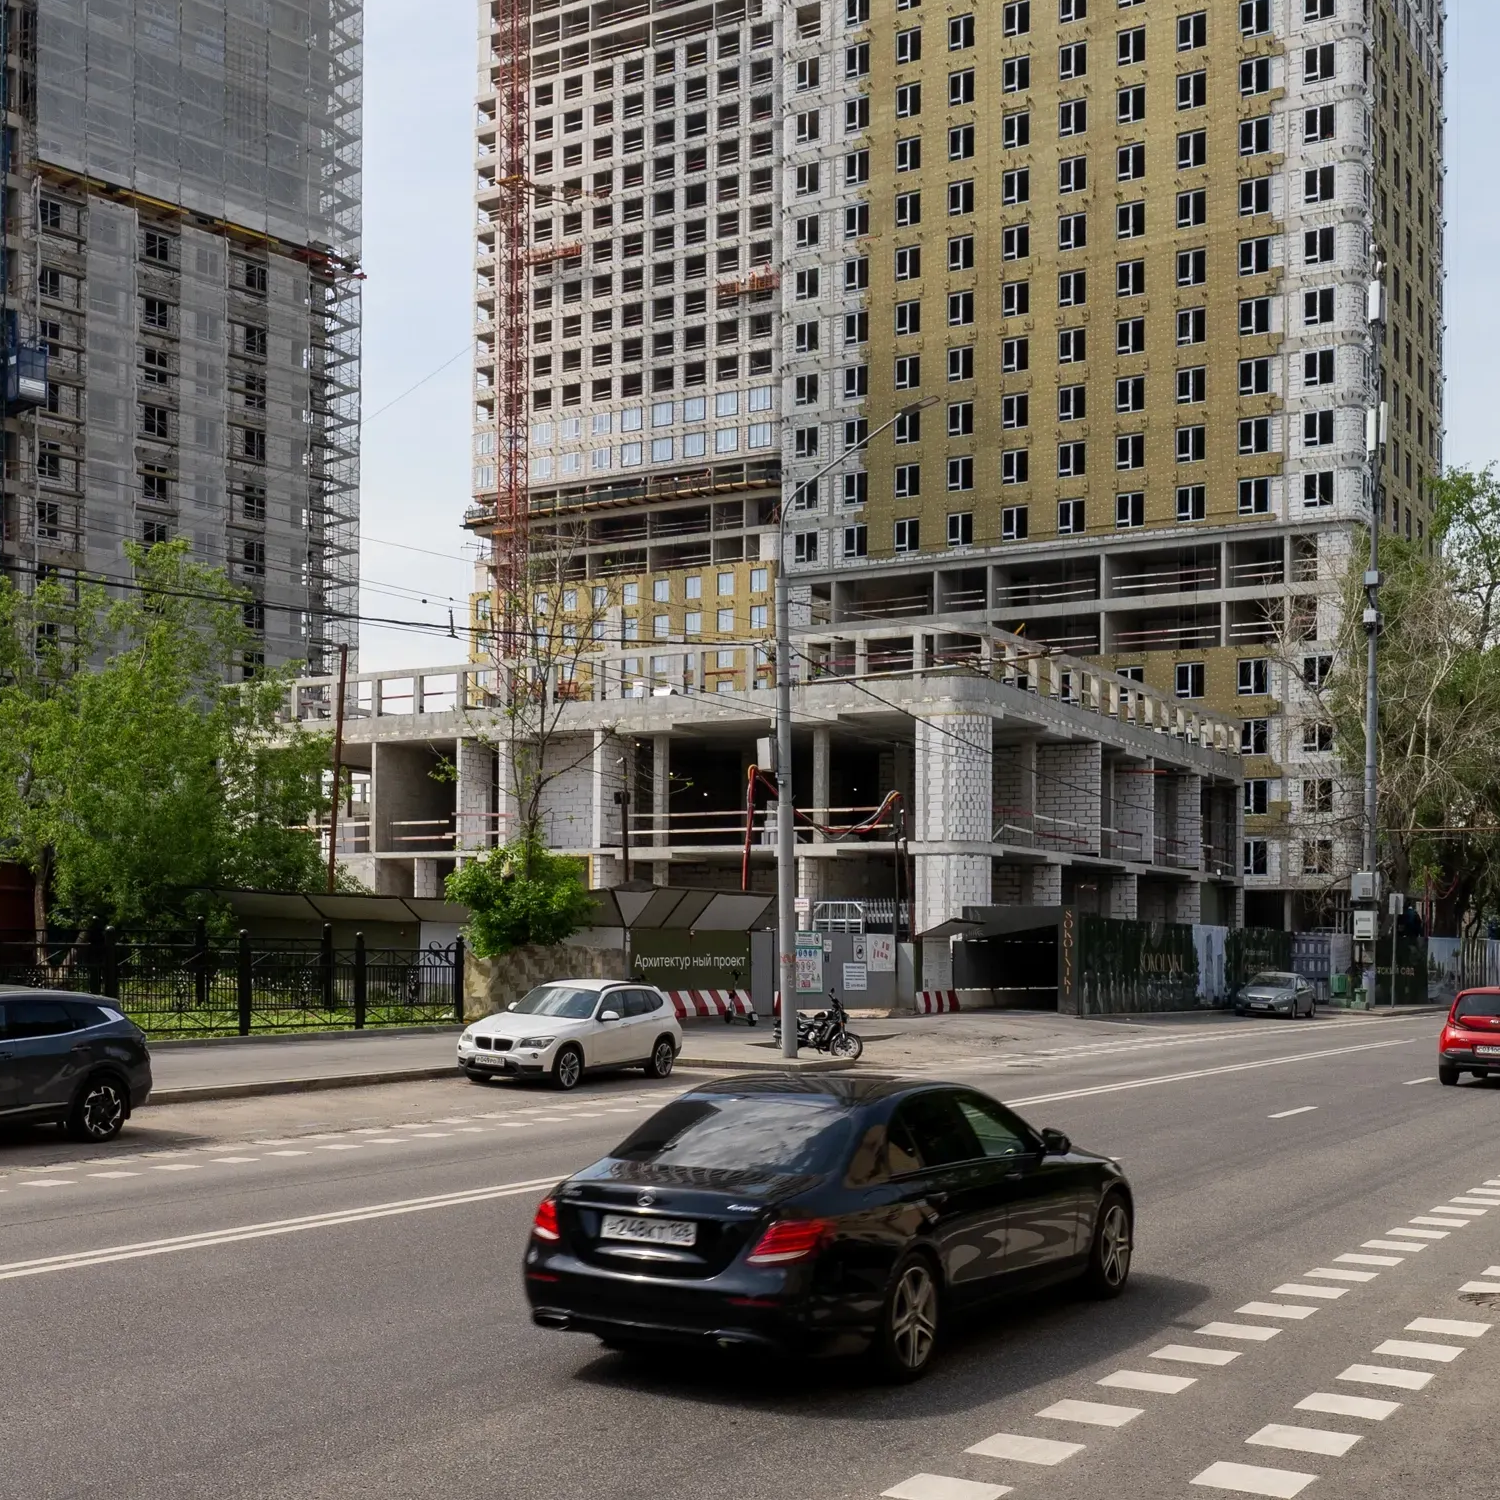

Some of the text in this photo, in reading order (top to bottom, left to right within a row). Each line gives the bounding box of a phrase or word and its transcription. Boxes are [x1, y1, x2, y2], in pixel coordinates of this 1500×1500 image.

[634, 953, 746, 971] Архитектур ный проект
[1401, 966, 1415, 977] сад
